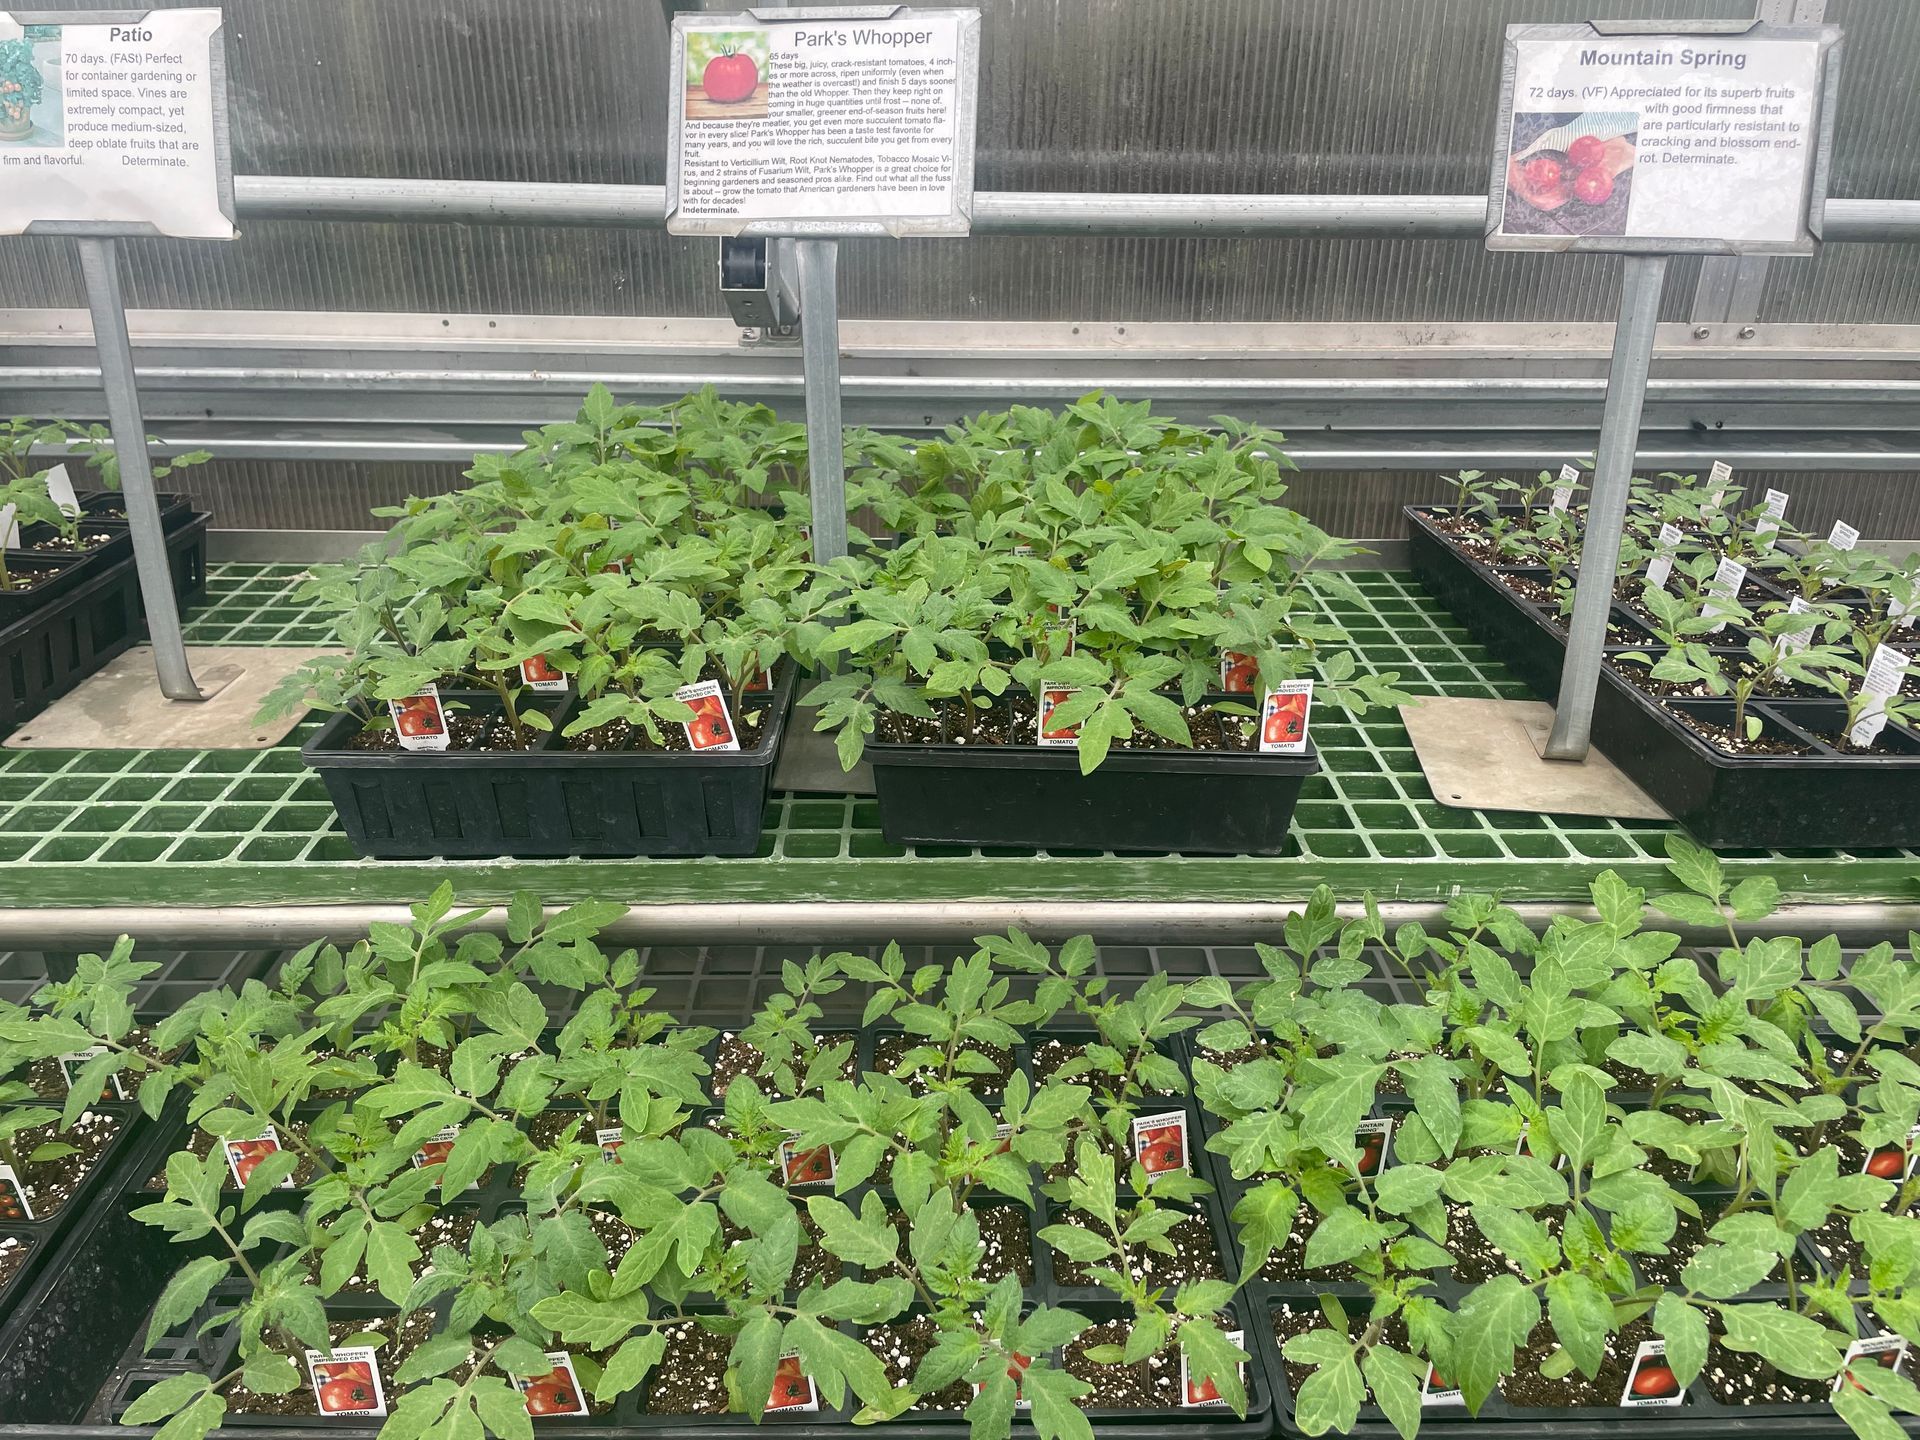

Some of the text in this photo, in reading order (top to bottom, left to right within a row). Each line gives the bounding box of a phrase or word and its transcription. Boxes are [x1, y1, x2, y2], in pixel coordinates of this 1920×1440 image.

[109, 27, 153, 42] Patio
[794, 29, 933, 48] Park's Whopper
[65, 53, 78, 64] 70
[80, 53, 108, 66] days.
[145, 52, 183, 64] Perfect
[769, 52, 799, 61] 65 days
[1580, 49, 1746, 70] Mountain Spring
[768, 61, 793, 70] These
[794, 60, 808, 70] big,
[830, 59, 887, 68] crack-resistant
[888, 58, 927, 67] tomatoes,
[929, 58, 934, 66] 4
[65, 70, 197, 84] for container gardening or
[767, 70, 778, 80] es
[789, 71, 809, 79] more
[840, 69, 860, 78] ripen
[861, 68, 897, 77] uniformly
[898, 68, 921, 77] (even
[922, 68, 944, 76] when
[66, 87, 188, 100] limited space. Vines are
[768, 91, 785, 99] than
[786, 90, 799, 98] the
[800, 89, 812, 98] old
[853, 88, 872, 96] Then
[874, 88, 891, 97] they
[892, 87, 912, 96] keep
[914, 87, 931, 96] right
[1529, 86, 1795, 100] 72 days. (VF) Appreciated for its superb fruits
[67, 104, 185, 118] extremely compact, yet
[766, 106, 946, 118] your smaller, greener end-of-season fruits here!
[1644, 102, 1784, 116] with good firmness that
[67, 121, 187, 134] produce medium-sized,
[684, 122, 701, 130] And
[702, 122, 734, 130] because
[735, 120, 761, 129] they're
[762, 119, 791, 128] meatier,
[793, 119, 808, 128] you
[809, 118, 822, 128] get
[904, 116, 932, 125] tomato
[1642, 119, 1800, 134] are particularly resistant to
[68, 138, 199, 151] deep oblate fruits that are
[1641, 135, 1691, 150] cracking
[1694, 136, 1718, 148] and
[1719, 136, 1771, 150] blossom
[684, 149, 702, 158] fruit.
[1638, 152, 1739, 165] rot. Determinate.
[2, 154, 190, 167] firm and flavorful. Determinate.
[684, 159, 719, 168] Resistant
[730, 158, 770, 167] Verticillium
[771, 157, 787, 166] Wilt,
[789, 156, 808, 165] Root
[809, 156, 828, 164] Knot
[878, 155, 910, 163] Tobacco
[912, 155, 939, 163] Mosaic
[683, 178, 721, 186] beginning
[721, 178, 760, 186] gardeners
[761, 176, 776, 185] and
[776, 176, 814, 184] seasoned
[815, 176, 832, 185] pros
[875, 174, 888, 182] out
[888, 174, 908, 182] what
[909, 174, 919, 182] all
[920, 174, 934, 182] the
[935, 174, 952, 182] fuss
[700, 196, 711, 205] for
[712, 196, 746, 205] decades!
[682, 206, 740, 214] Indeterminate.
